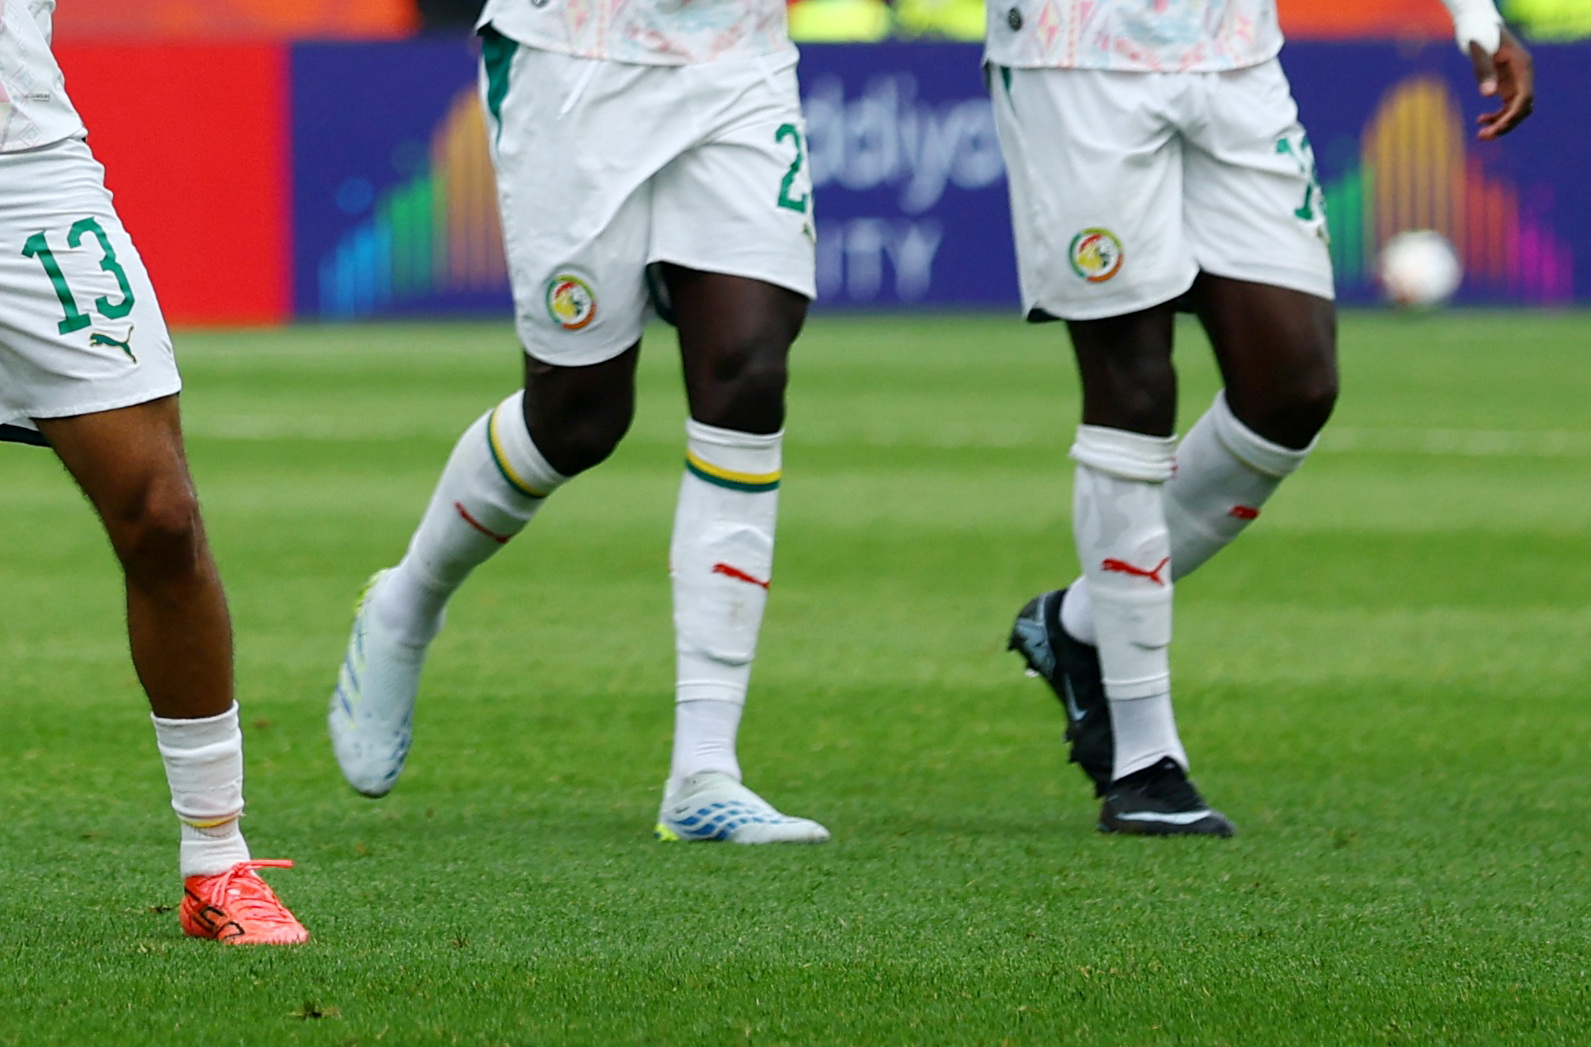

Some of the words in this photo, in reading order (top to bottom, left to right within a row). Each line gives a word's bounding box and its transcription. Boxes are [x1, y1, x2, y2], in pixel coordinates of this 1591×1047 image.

[774, 122, 807, 215] 2
[21, 216, 136, 336] 13
[815, 217, 945, 303] ITY
